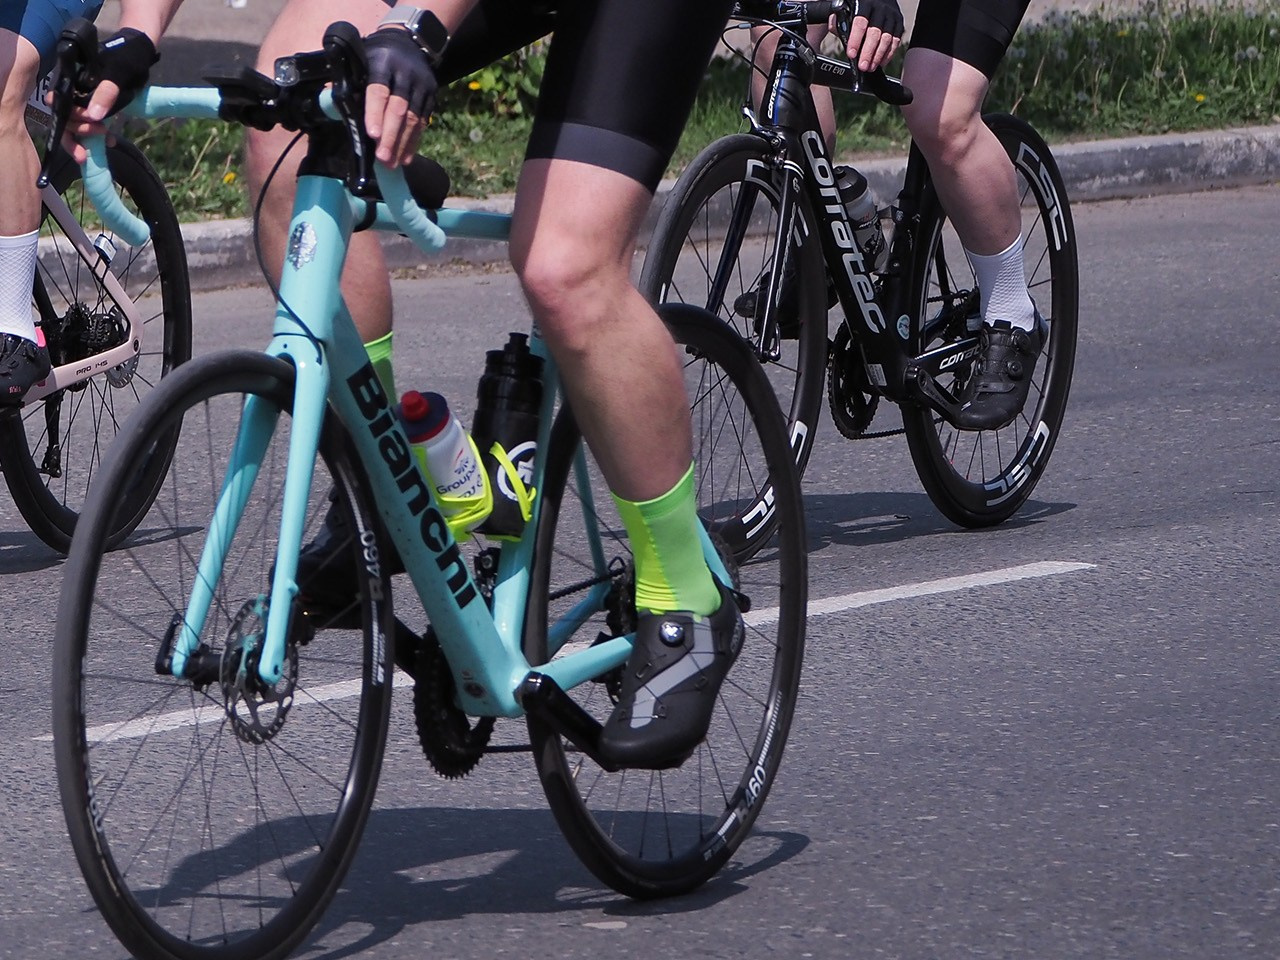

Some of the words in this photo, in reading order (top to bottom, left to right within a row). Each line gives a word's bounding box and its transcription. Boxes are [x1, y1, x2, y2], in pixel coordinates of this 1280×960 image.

[801, 130, 887, 334] corratec
[76, 365, 92, 376] PRO
[347, 360, 477, 610] Bianchi
